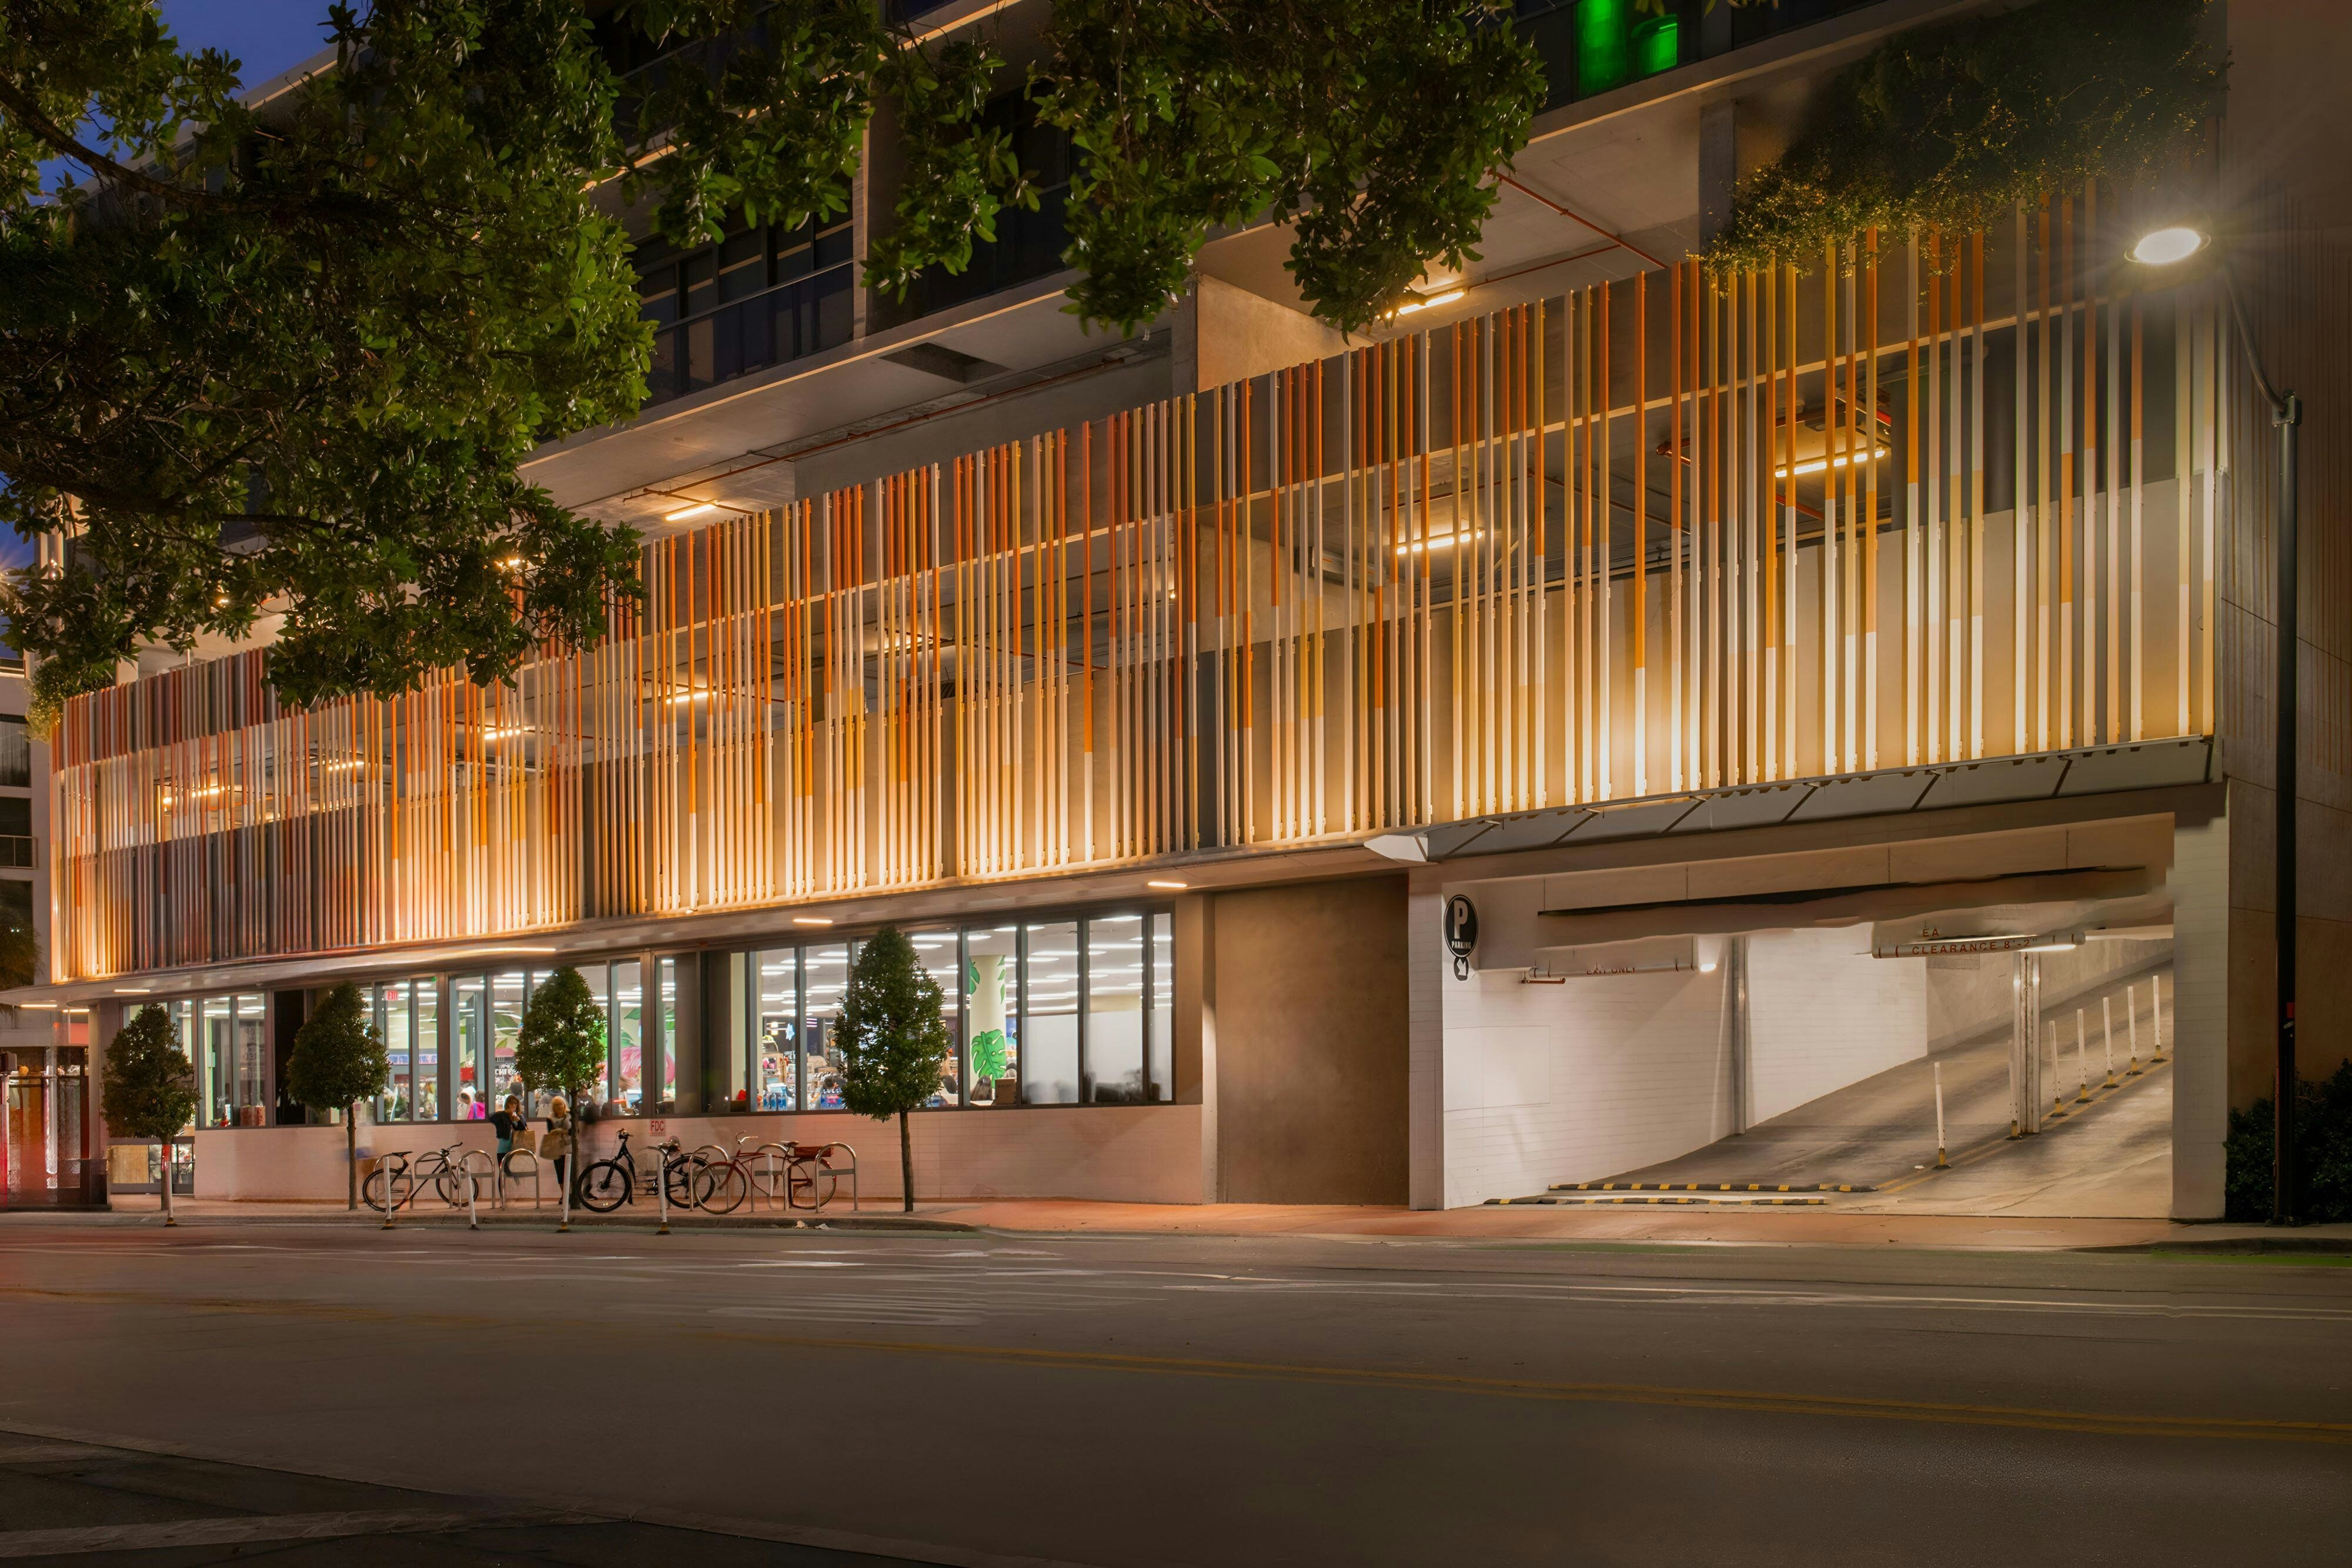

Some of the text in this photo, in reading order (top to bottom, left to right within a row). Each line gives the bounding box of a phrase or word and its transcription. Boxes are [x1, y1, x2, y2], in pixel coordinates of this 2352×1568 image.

[1454, 900, 1468, 938] P
[1912, 941, 1997, 955] CLEARANCE
[650, 1120, 664, 1132] FDC
